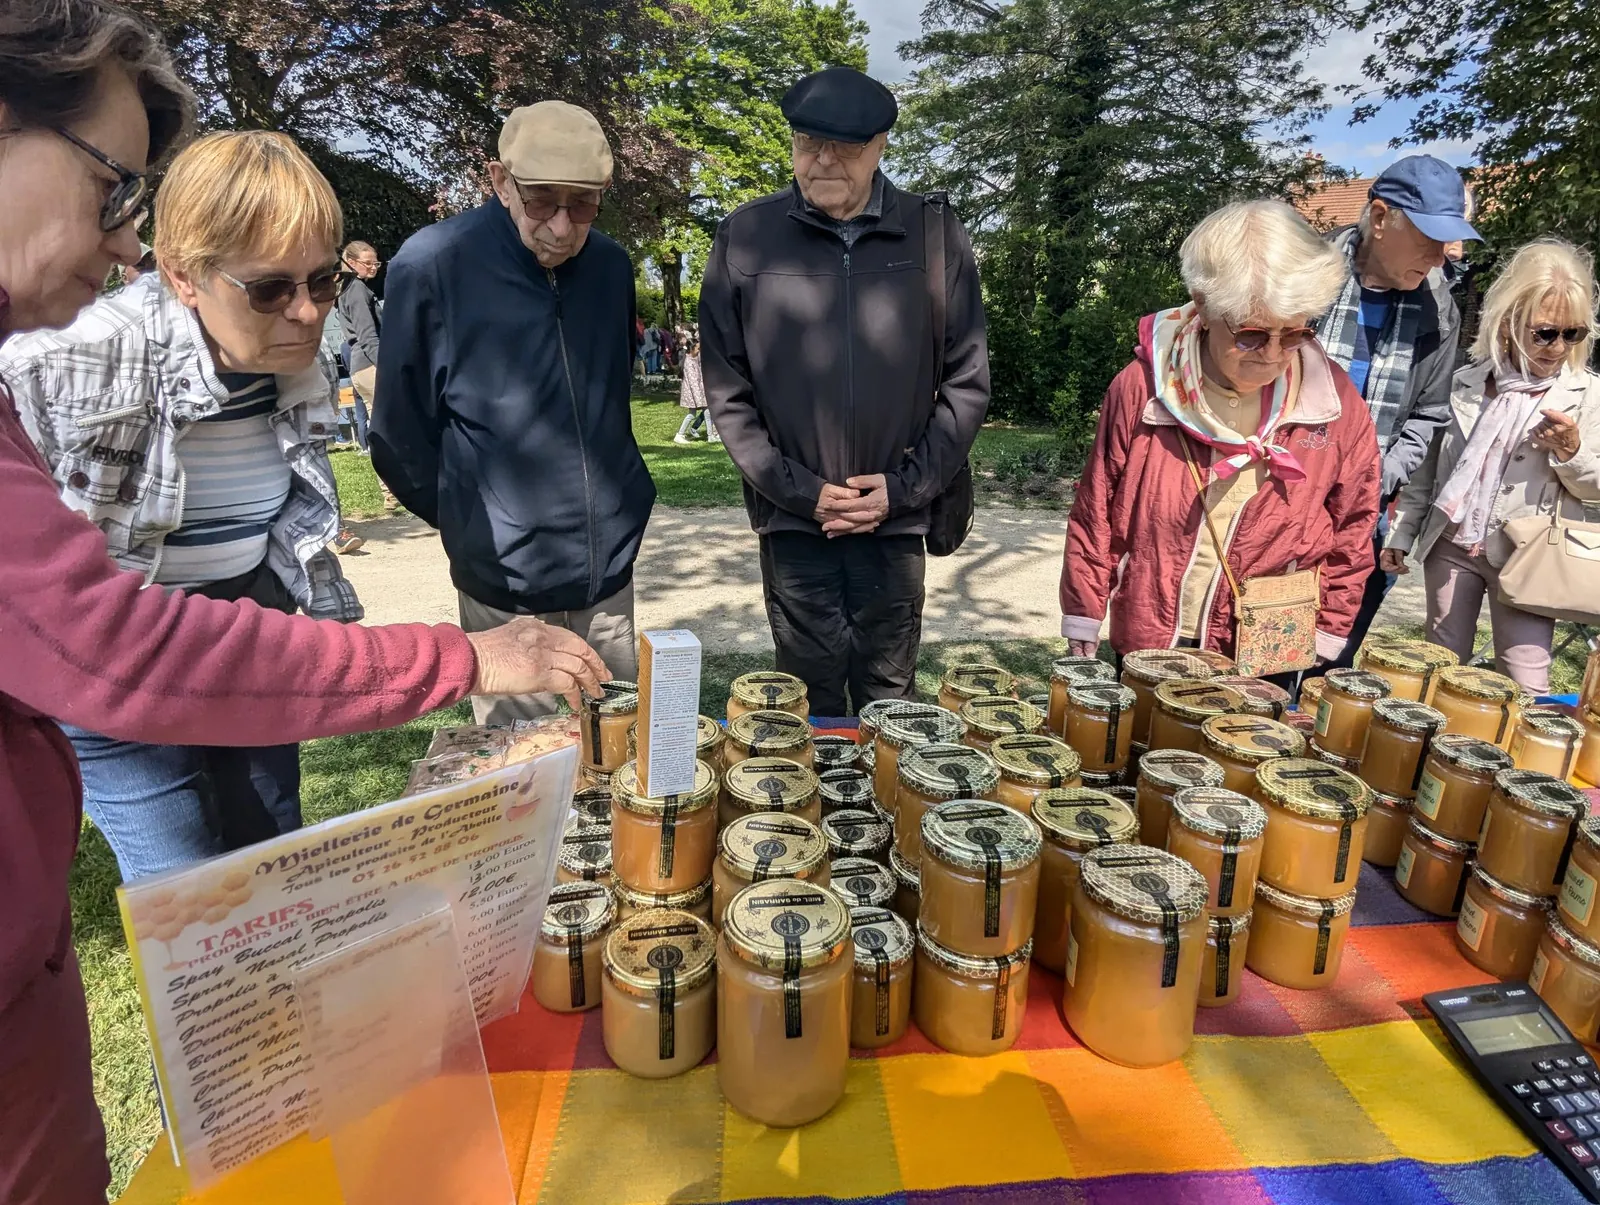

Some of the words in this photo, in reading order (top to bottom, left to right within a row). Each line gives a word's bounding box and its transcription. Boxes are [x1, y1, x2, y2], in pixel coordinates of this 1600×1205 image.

[256, 824, 382, 875] Miellerie
[391, 813, 414, 830] de
[424, 780, 520, 821] Germaine
[286, 838, 392, 882] Apiculteur
[411, 804, 498, 841] Producteur
[282, 876, 322, 894] Tous
[329, 866, 350, 878] les
[356, 845, 417, 871] produits
[421, 835, 436, 848] de
[440, 813, 502, 840] l'Abeille
[187, 928, 272, 969] PRODUITS
[279, 920, 298, 934] DE
[306, 903, 340, 922] BIEN
[463, 833, 524, 862] PROPOLIS
[234, 928, 302, 964] Buccal
[310, 898, 386, 934] Propolis
[504, 838, 536, 856] Euros
[752, 898, 790, 906] SARRASIN
[171, 976, 236, 1011] Spray
[245, 942, 307, 976] Nasal
[314, 911, 388, 948] Propolis
[504, 852, 536, 869] Euros
[197, 898, 315, 952] TARIFS
[630, 928, 667, 937] SARRASIN
[176, 982, 259, 1026] Propolis
[179, 998, 258, 1044] Gommes
[182, 1008, 277, 1056] Dentifrice
[190, 1054, 250, 1086] Savon
[256, 1028, 300, 1051] Mie
[197, 1080, 254, 1114] Savon
[1513, 1084, 1530, 1094] MC
[1534, 1079, 1550, 1090] MR
[1554, 1098, 1566, 1111] 7
[1573, 1095, 1586, 1107] 8
[1554, 1123, 1565, 1134] C
[1575, 1119, 1588, 1132] 4
[1572, 1145, 1590, 1157] ON
